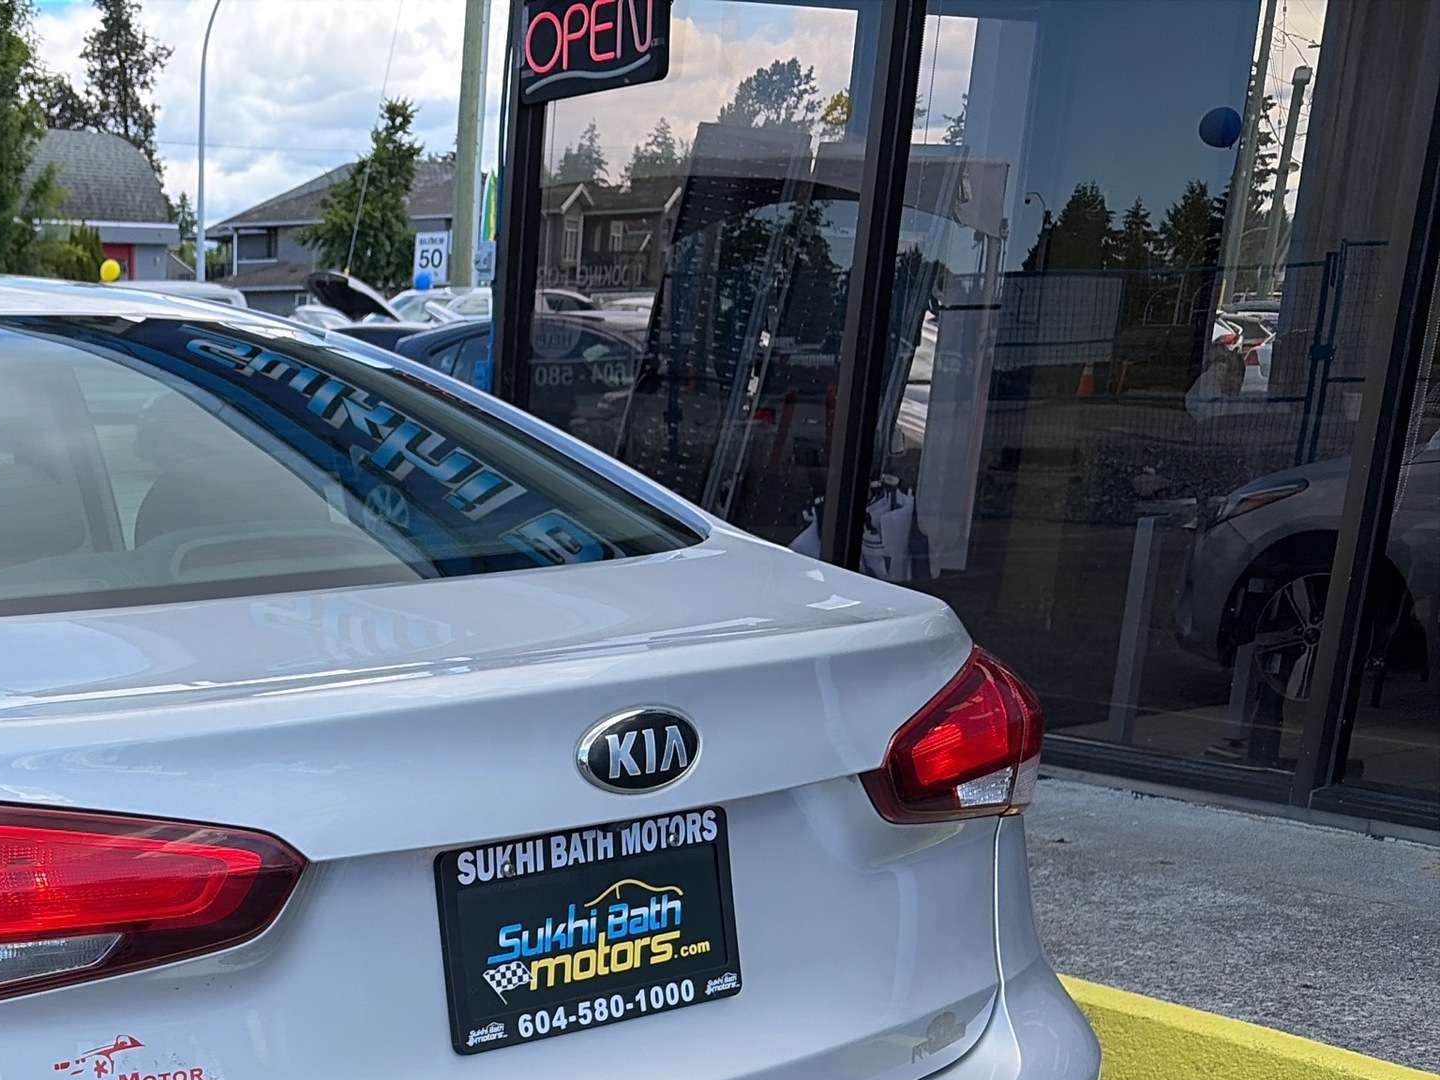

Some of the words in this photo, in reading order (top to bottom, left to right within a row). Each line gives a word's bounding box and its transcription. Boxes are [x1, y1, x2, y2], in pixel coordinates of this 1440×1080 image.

[525, 0, 654, 74] OPEN
[418, 247, 444, 270] 50
[605, 725, 688, 779] KIA
[457, 840, 545, 886] SUKHI
[550, 829, 614, 869] BATH
[621, 809, 718, 857] MOTORS
[487, 903, 598, 965] Sukhi
[607, 894, 683, 939] Bath
[517, 979, 695, 1039] 604-580-1000
